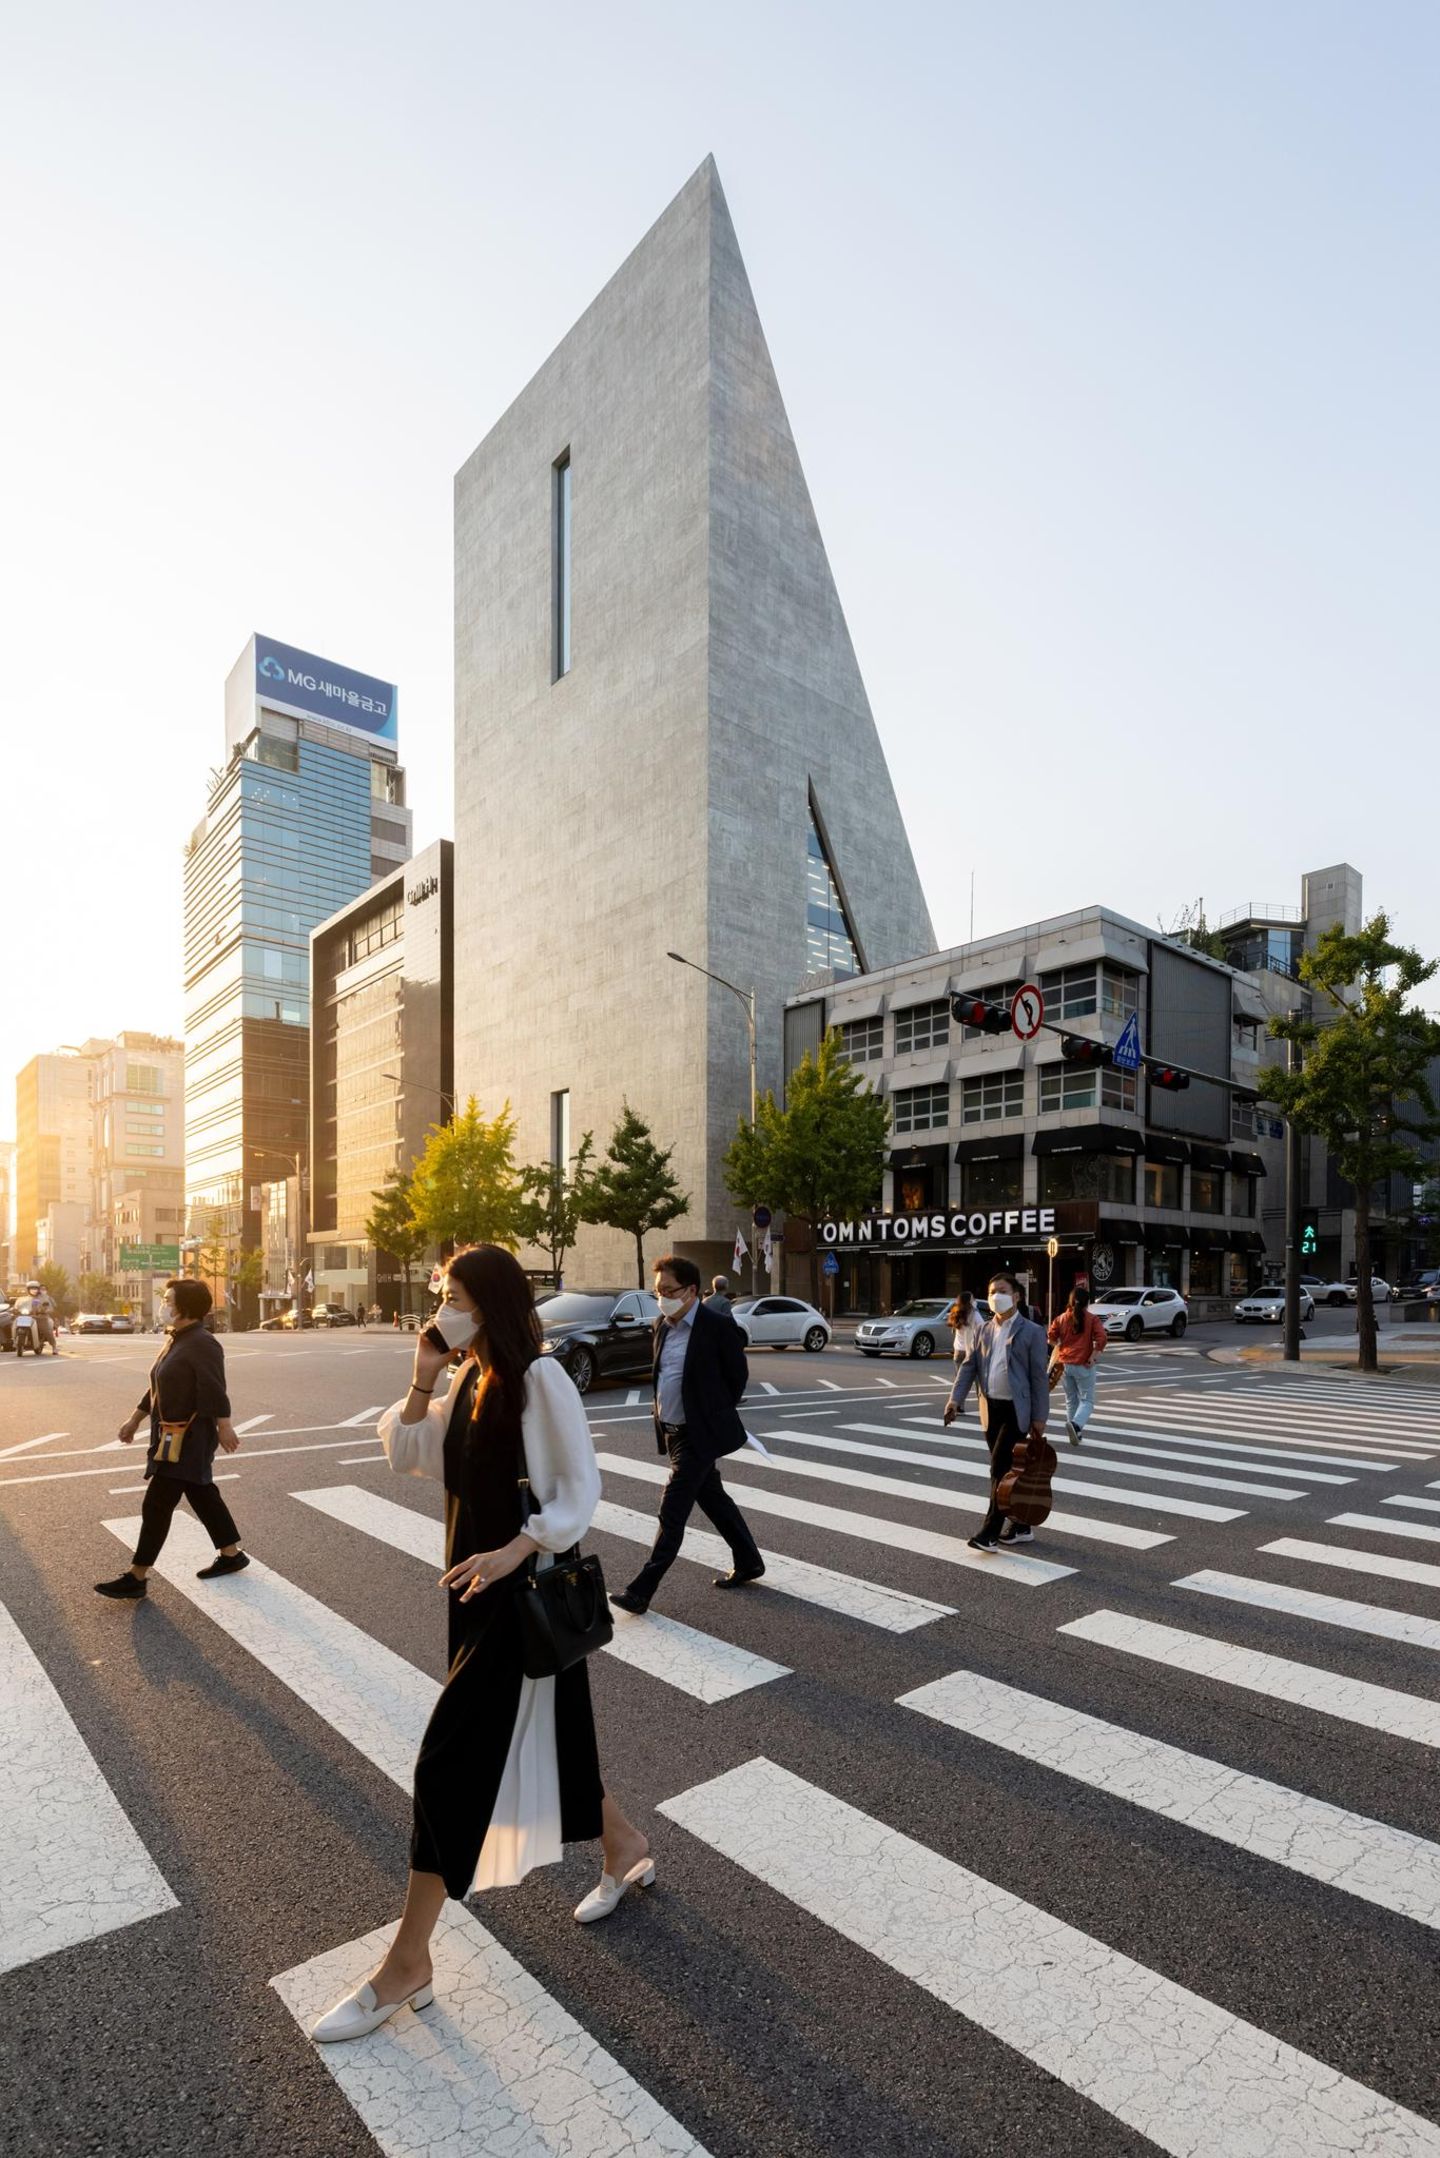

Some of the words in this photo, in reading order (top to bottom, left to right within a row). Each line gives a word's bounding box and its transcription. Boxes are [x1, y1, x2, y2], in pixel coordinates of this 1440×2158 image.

[809, 1221, 854, 1243] OM
[858, 1219, 872, 1241] N
[877, 1215, 946, 1240] TOMS
[950, 1208, 1055, 1237] COFFEE
[1302, 1241, 1317, 1253] 21
